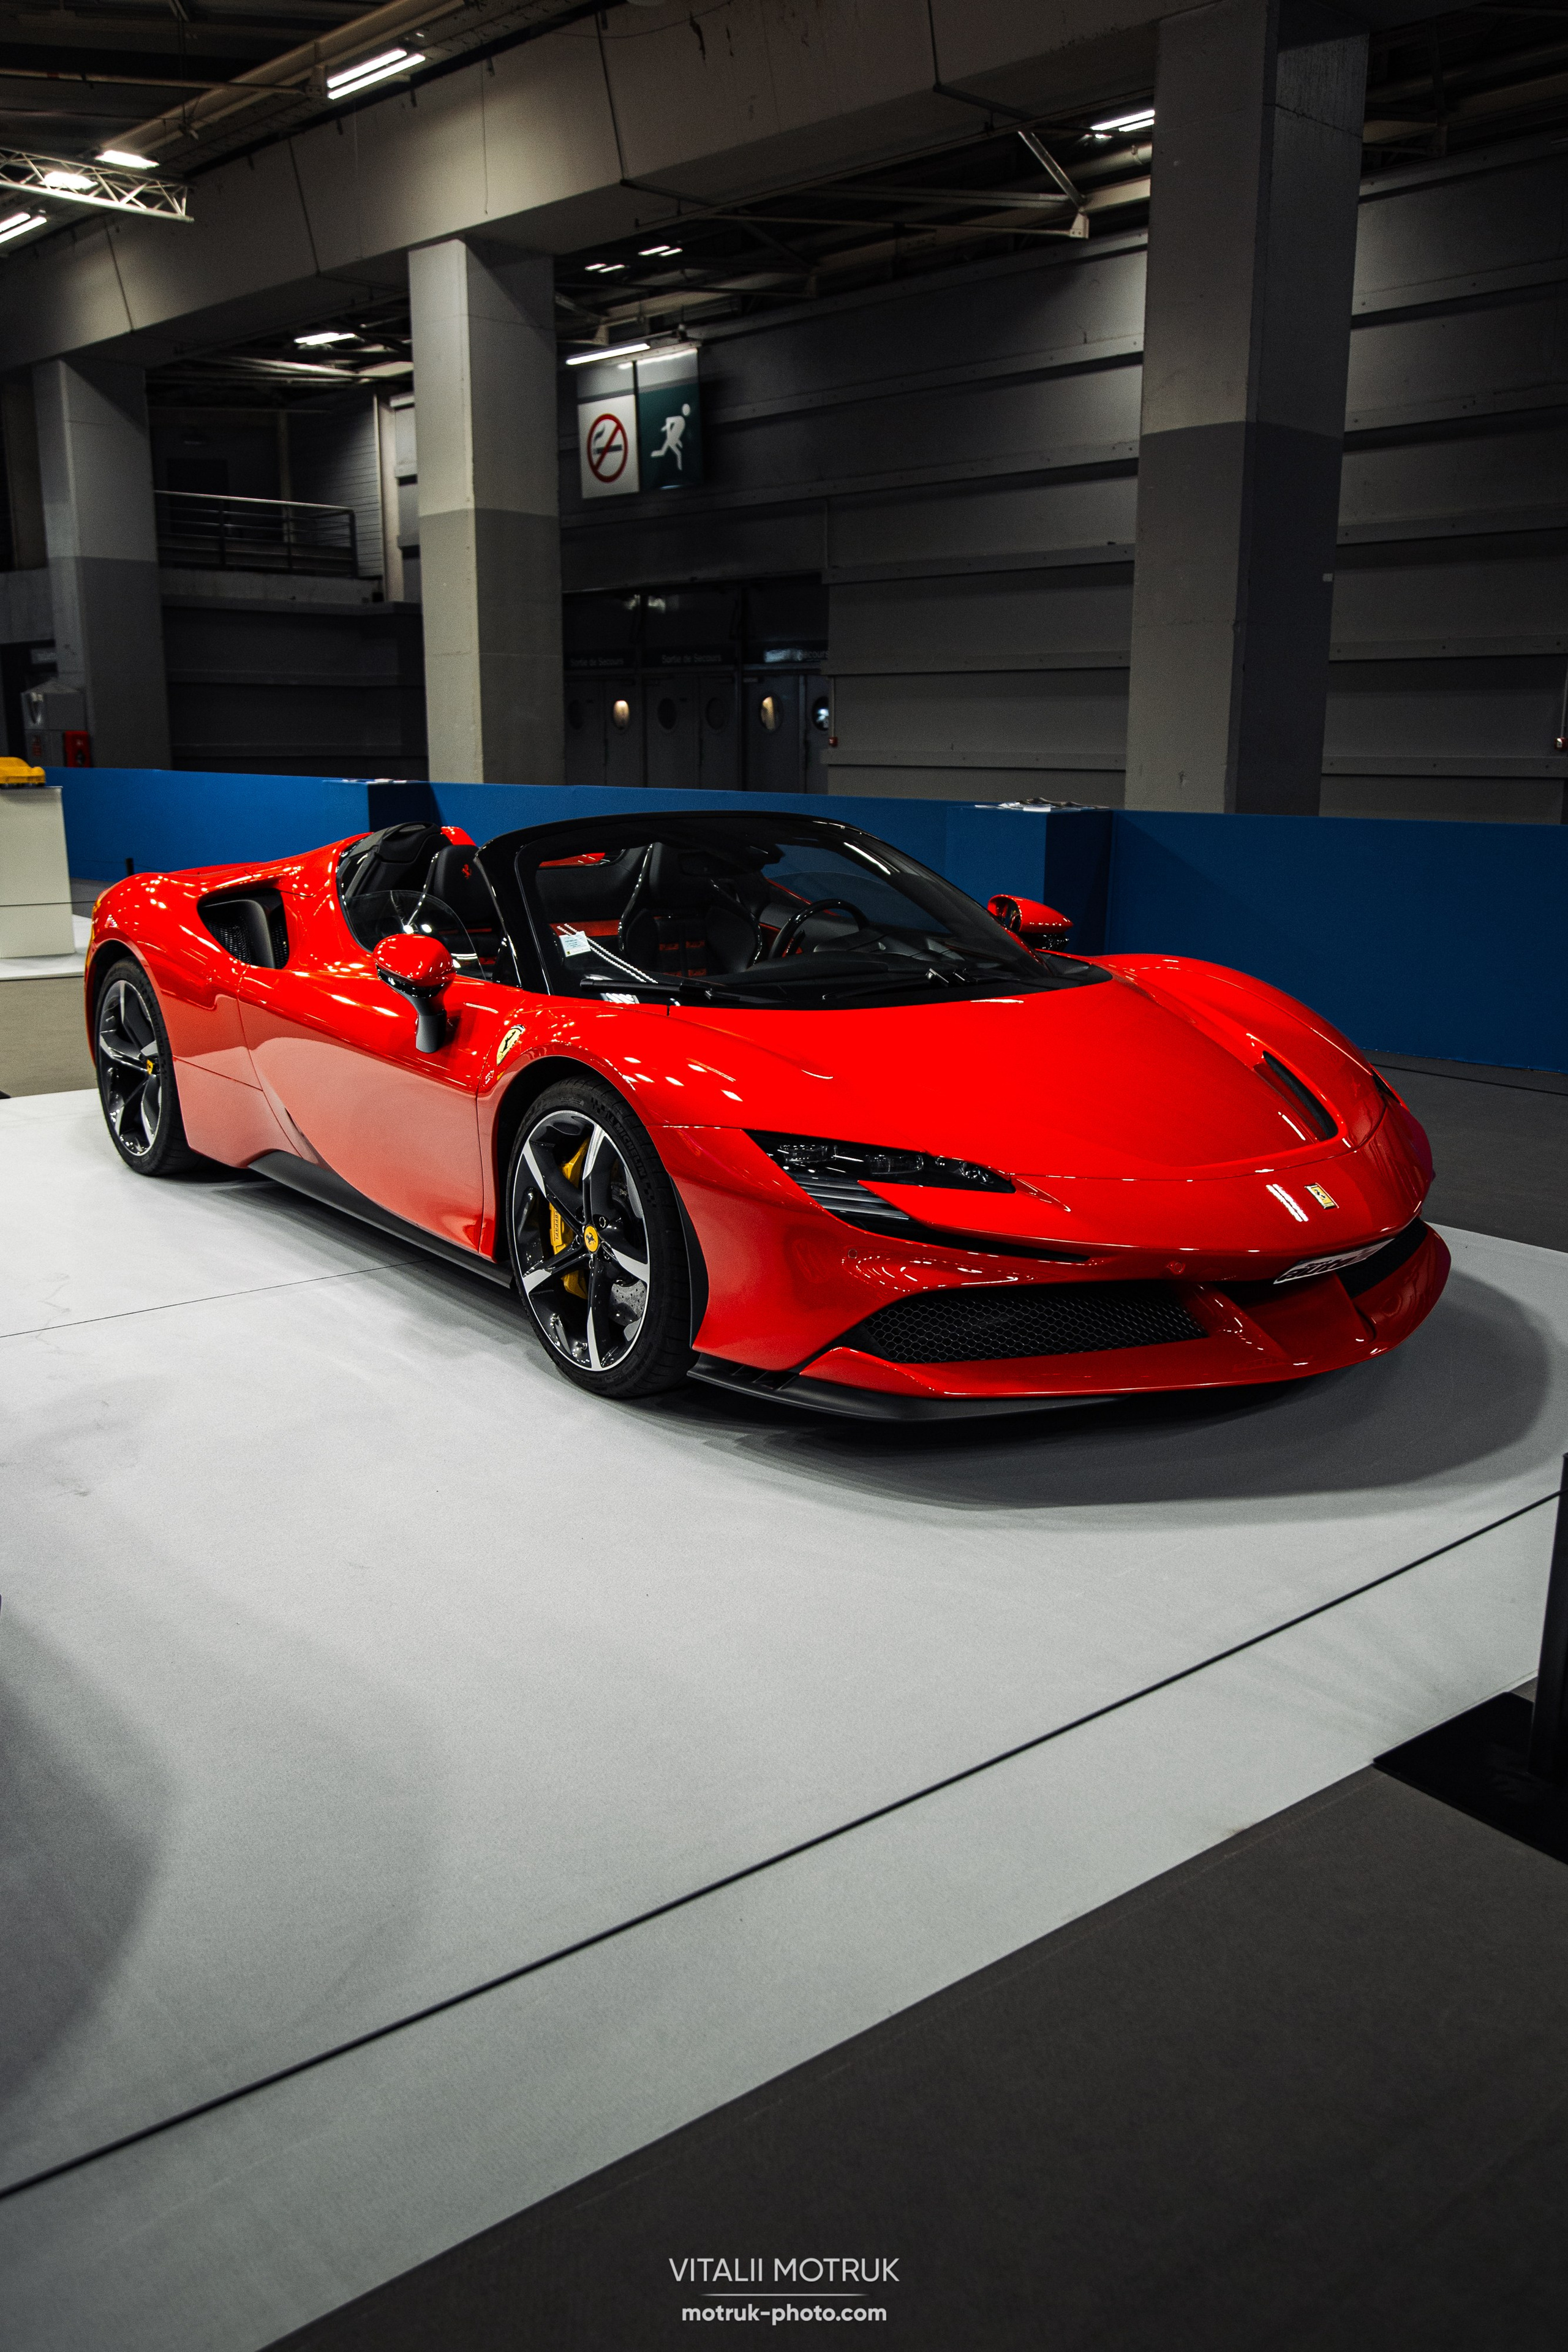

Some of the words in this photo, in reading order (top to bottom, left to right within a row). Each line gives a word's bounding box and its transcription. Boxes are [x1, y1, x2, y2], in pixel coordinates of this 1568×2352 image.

[683, 655, 692, 663] de
[693, 653, 722, 663] Secours
[614, 1121, 647, 1177] MICHELIN
